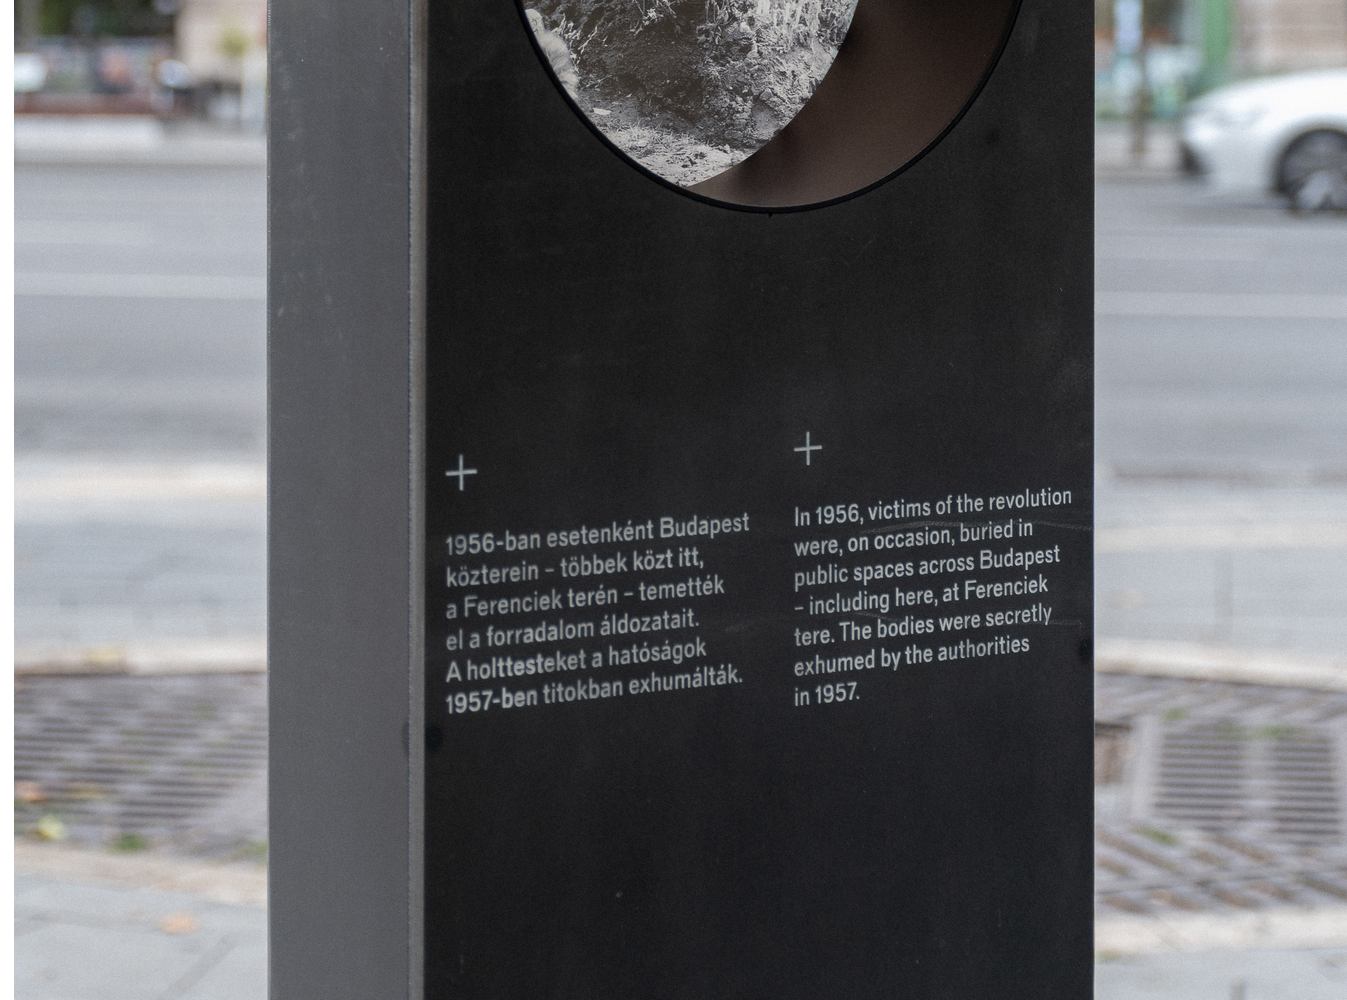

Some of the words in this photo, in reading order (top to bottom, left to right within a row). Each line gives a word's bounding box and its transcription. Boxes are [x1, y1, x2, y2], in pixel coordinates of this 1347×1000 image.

[795, 507, 810, 526] In
[816, 503, 863, 525] 1956,
[868, 499, 931, 520] victims
[936, 495, 952, 515] of
[956, 493, 984, 513] the
[989, 487, 1071, 510] revolution
[446, 530, 540, 555] 1956-ban
[547, 520, 654, 547] esetenként
[660, 512, 749, 539] Budapest
[794, 539, 843, 556] were,
[848, 536, 868, 552] on
[874, 528, 955, 549] occasion,
[960, 519, 1013, 542] buried
[1019, 518, 1032, 537] in
[447, 561, 538, 587] közterein
[560, 552, 627, 577] többek
[633, 549, 673, 571] közt
[679, 547, 703, 569] itt,
[795, 564, 848, 592] public
[854, 562, 914, 586] spaces
[919, 556, 974, 575] across
[980, 545, 1060, 570] Budapest
[446, 604, 456, 619] a
[465, 589, 562, 617] Ferenciek
[567, 584, 617, 607] terén
[639, 574, 724, 601] temették
[810, 591, 889, 615] including
[896, 587, 938, 606] here,
[943, 583, 959, 602] at
[965, 574, 1048, 600] Ferenciek
[446, 629, 463, 650] el
[470, 633, 480, 648] a
[486, 619, 594, 646] forradalom
[600, 608, 699, 635] áldozatait.
[794, 628, 835, 646] tere.
[839, 621, 872, 641] The
[878, 615, 934, 638] bodies
[939, 614, 980, 631] were
[986, 602, 1052, 626] secretly
[446, 661, 462, 682] A
[467, 649, 586, 680] holttesteket
[592, 652, 602, 667] a
[609, 637, 706, 665] hatóságok
[794, 648, 875, 676] exhumed
[881, 648, 901, 671] by
[905, 644, 933, 664] the
[938, 635, 1029, 661] authorities
[446, 687, 537, 714] 1957-ben
[543, 678, 623, 703] titokban
[629, 664, 742, 694] exhumálták.
[795, 688, 809, 706] in
[815, 681, 859, 704] 1957.
